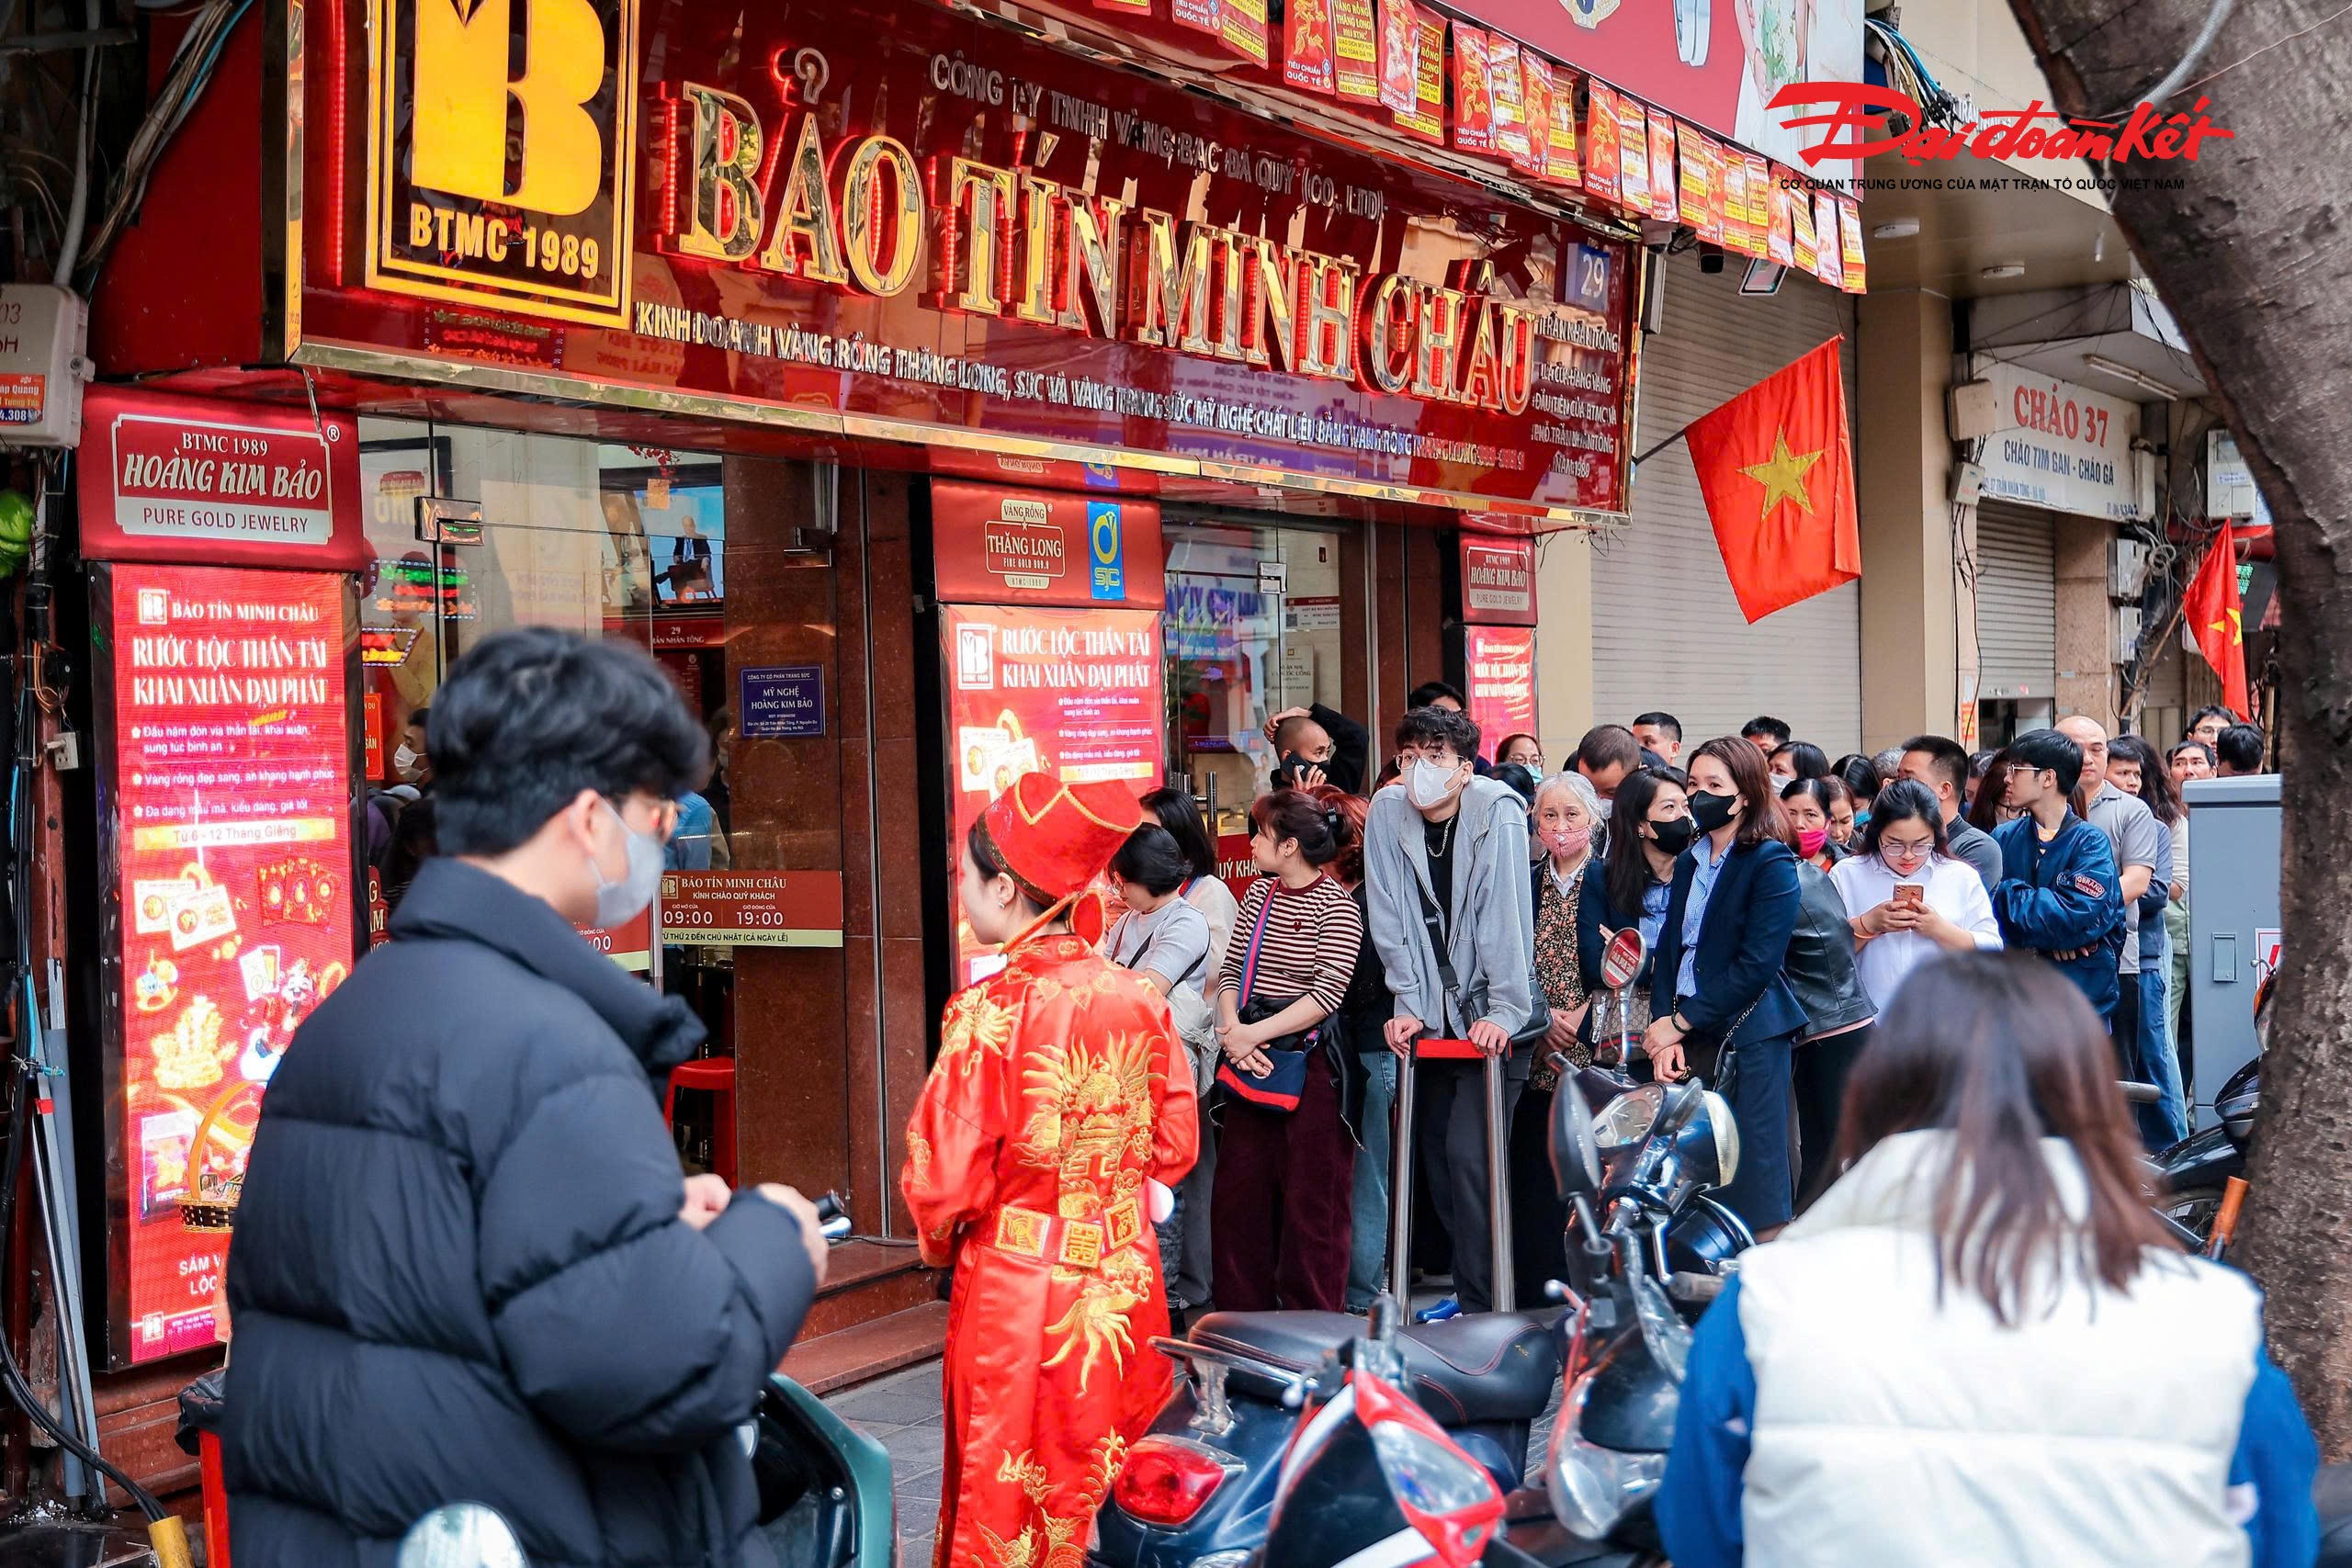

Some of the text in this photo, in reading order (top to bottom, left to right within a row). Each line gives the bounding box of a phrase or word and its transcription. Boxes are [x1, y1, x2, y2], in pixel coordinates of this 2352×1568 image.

[1176, 8, 1210, 27] QUỐC TẾ
[1286, 72, 1321, 85] QUỐC TẾ
[1421, 62, 1439, 74] LONG
[930, 50, 1003, 106] CÔNG
[1010, 77, 1043, 117] TY
[1049, 90, 1108, 140] TNHH
[1114, 108, 1172, 159] VÀNG
[1225, 143, 1252, 183] ĐÁ
[1457, 136, 1477, 147] QUỐC
[1478, 139, 1487, 148] TẾ
[411, 203, 600, 278] BTMC 1989
[679, 47, 1537, 415] BẢO TÍN MINH CHÂU
[1582, 251, 1605, 297] 29
[635, 301, 691, 342] KINH
[693, 311, 772, 356] DOANH
[775, 322, 832, 365] VÀNG
[834, 332, 891, 375] RỒNG
[895, 346, 956, 387] THĂNG
[1046, 371, 1068, 404] VÀ
[1071, 375, 1114, 412] VÀNG
[1115, 386, 1163, 418] TRANG
[1164, 390, 1193, 423] SỨC
[1194, 397, 1216, 427] MỸ
[1216, 402, 1253, 440] NGHỆ
[1254, 404, 1288, 438] CHẤT
[1316, 411, 1349, 446] BẰNG
[1350, 418, 1382, 453] VÀNG
[1382, 423, 1412, 456] RỒNG
[13, 384, 40, 396] Quang
[2085, 406, 2109, 448] 37
[182, 432, 269, 457] BTMC 1989
[1574, 457, 1590, 479] 1989
[2033, 446, 2050, 470] TIM
[2052, 451, 2070, 476] GAN
[123, 446, 322, 500] HOÀNG KIM BẢO
[143, 507, 309, 533] PURE GOLD JEWELRY
[1003, 502, 1045, 519] VÀNG RỒNG
[988, 531, 1062, 558] THĂNG LONG
[1003, 557, 1016, 568] FINE
[1018, 558, 1032, 569] GOLD
[1095, 567, 1120, 592] SJC
[1470, 562, 1526, 587] HOÀNG KIM BẢO
[173, 600, 320, 622] BẢO TÍN MINH CHÂU
[671, 626, 681, 635] 29
[133, 633, 327, 671] RƯỚC LỘC THẦN TÀI
[1001, 625, 1150, 659] RƯỚC LỘC THẦN TÀI
[1002, 660, 1151, 691] KHAI XUÂN ĐẠI PHÁT
[133, 671, 328, 709] KHAI XUÂN ĐẠI PHÁT
[763, 685, 799, 697] MỸ NGHỆ
[752, 697, 813, 710] HOÀNG KIM BẢO
[143, 742, 222, 756] sung an
[245, 772, 257, 782] an
[259, 770, 288, 783] khang
[210, 829, 221, 840] 12
[1219, 854, 1261, 880] UÝ KHÁ
[682, 875, 787, 889] BẢO TÍN MINH CHÂU
[693, 890, 775, 900] KÍNH CHÀO QUÝ KHÁCH
[663, 910, 713, 925] 09:00
[736, 911, 784, 926] 19:00
[671, 931, 685, 941] THỨ
[691, 930, 706, 941] ĐẾN
[707, 931, 722, 942] CHỦ
[757, 932, 776, 942] NGÀY
[777, 931, 788, 942] LỄ)
[190, 1274, 218, 1296] LỘC
